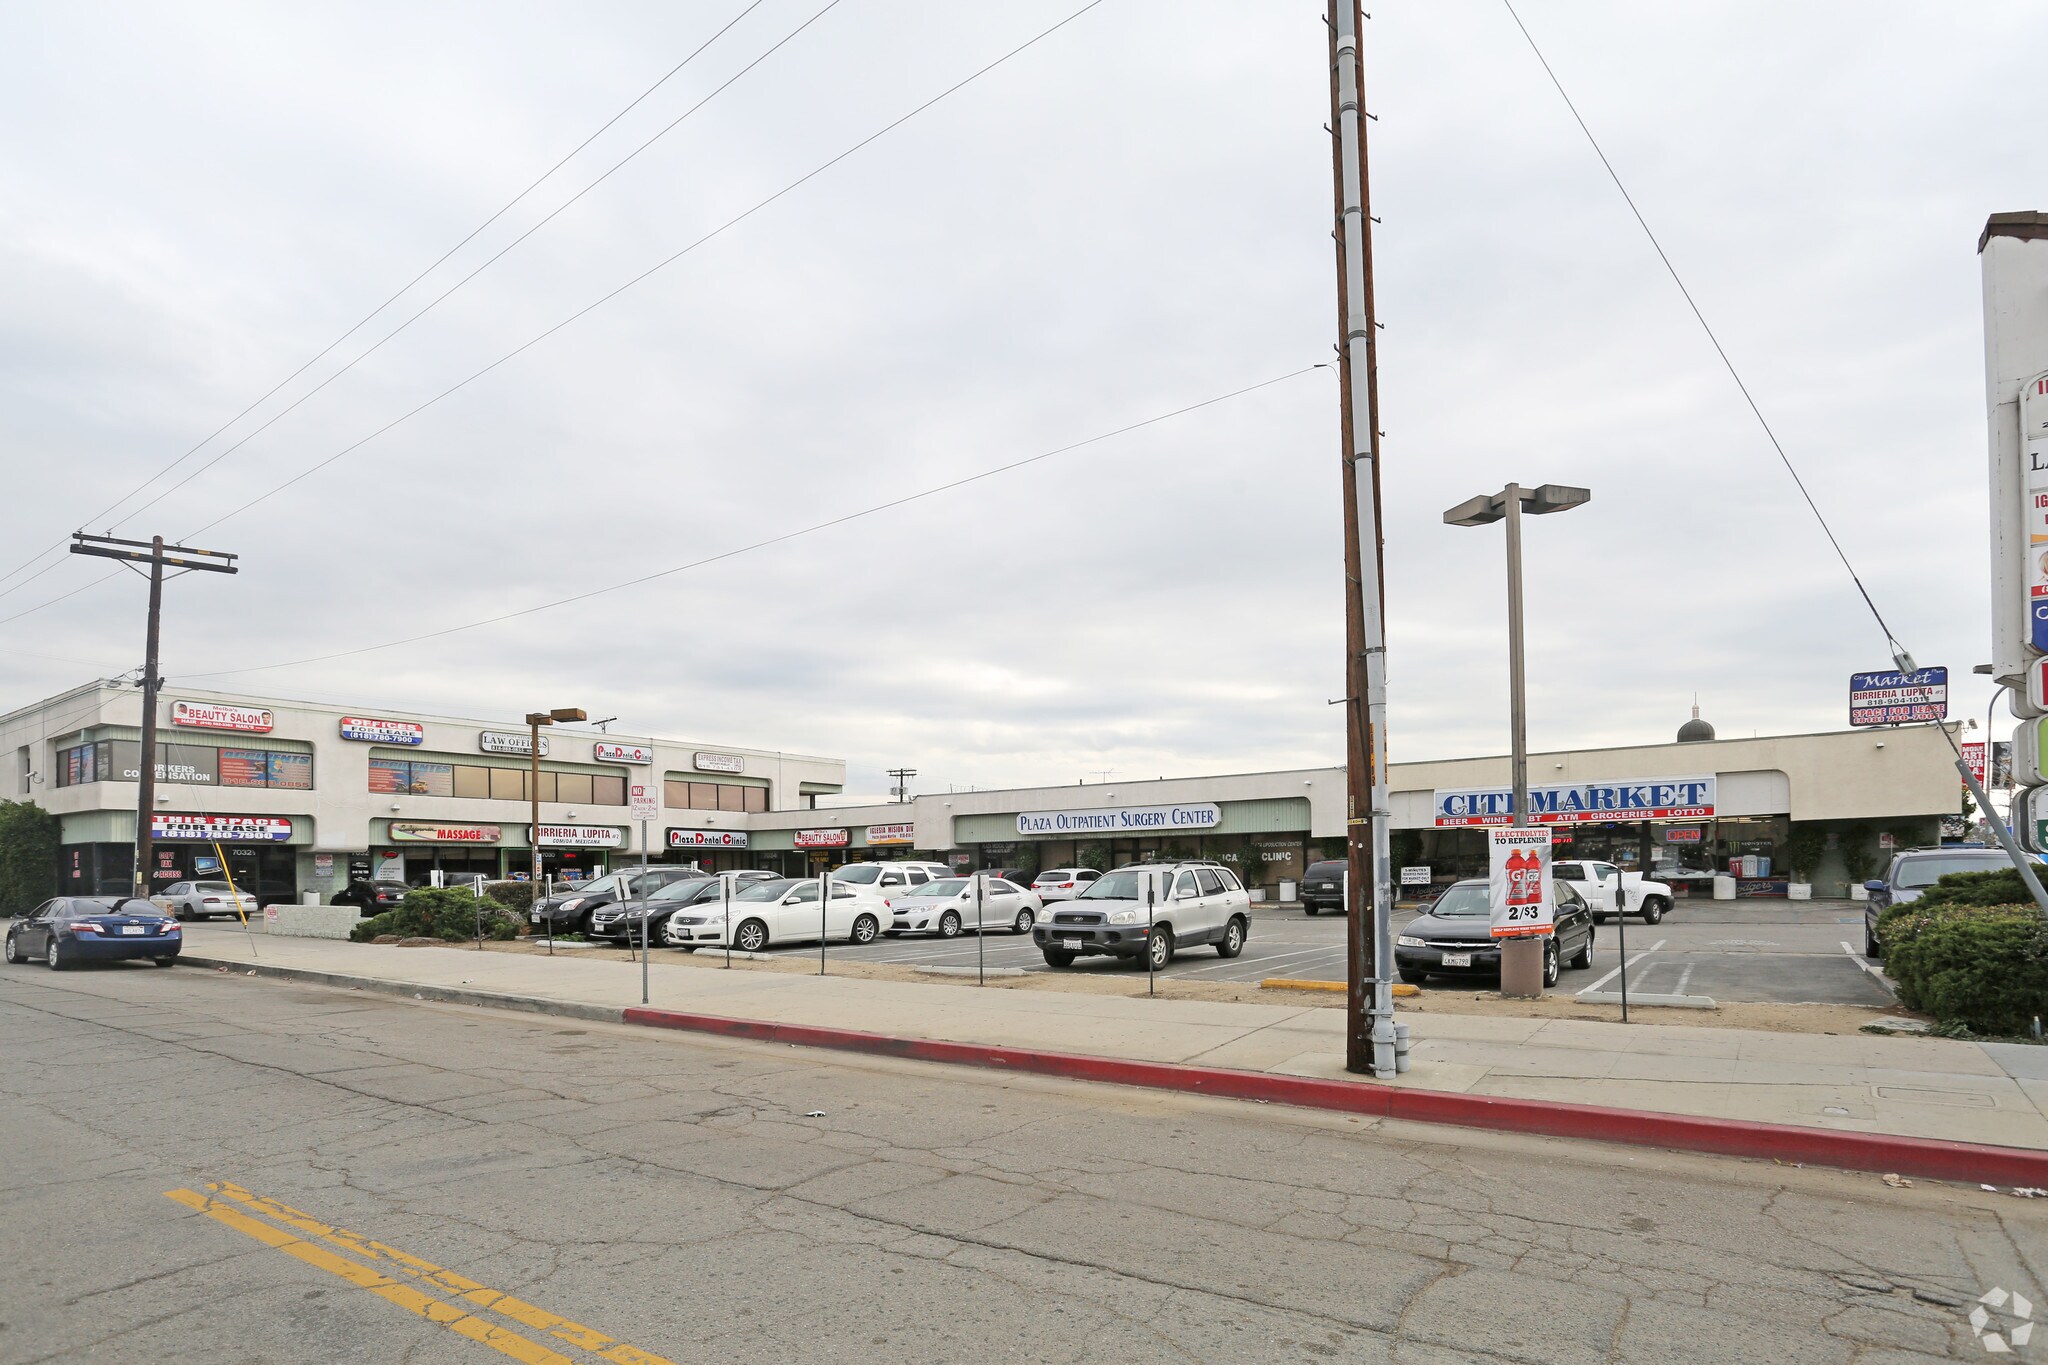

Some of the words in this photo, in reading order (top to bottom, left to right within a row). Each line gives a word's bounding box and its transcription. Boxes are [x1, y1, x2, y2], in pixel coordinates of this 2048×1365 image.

[1863, 671, 1932, 688] Market
[1853, 689, 1897, 701] BIRRIERIA
[1901, 687, 1933, 697] LUPITA
[189, 708, 227, 721] BEAUTY
[230, 712, 261, 724] SALON
[1853, 708, 1886, 718] SPACE
[1889, 706, 1910, 716] FOR
[1913, 704, 1945, 714] LEASE
[350, 719, 417, 731] OFFICES
[379, 728, 416, 736] LEASE
[374, 734, 413, 743] 780-7900
[483, 735, 506, 745] LAW
[1962, 751, 1983, 760] ART
[123, 769, 211, 781] COENSATION
[632, 786, 643, 796] NO
[1528, 782, 1707, 814] MARKET
[153, 815, 206, 824] THIS
[213, 817, 280, 826] SPACE
[1020, 815, 1052, 831] PLAZA
[1056, 813, 1116, 829] OUTPATIENT
[1121, 811, 1167, 827] SURGERY
[1171, 808, 1215, 824] CENTER
[1442, 817, 1469, 825] BEER
[1481, 816, 1508, 824] WINE
[1528, 814, 1542, 823] BT
[1556, 813, 1579, 822] ATM
[1590, 810, 1654, 820] GROCERIES
[1667, 808, 1705, 817] LOTTO
[166, 823, 206, 831] FOR
[870, 826, 886, 834] IGLESIA
[161, 830, 202, 838] (818)
[205, 831, 273, 839] 780-7900
[437, 829, 481, 840] MASSAGE
[582, 829, 611, 839] LUPITA
[671, 831, 695, 844] Plaza
[695, 832, 722, 845] Dental
[722, 833, 747, 846] Clinic
[801, 833, 822, 842] BEAUTY
[823, 833, 841, 841] SALON
[1494, 830, 1549, 838] ELECTROLYTES
[1667, 830, 1700, 841] OPEN
[1495, 837, 1507, 845] TO
[1508, 836, 1547, 844] REPLENISH
[1736, 881, 1773, 896] odgers
[1508, 905, 1539, 920] 2/$3
